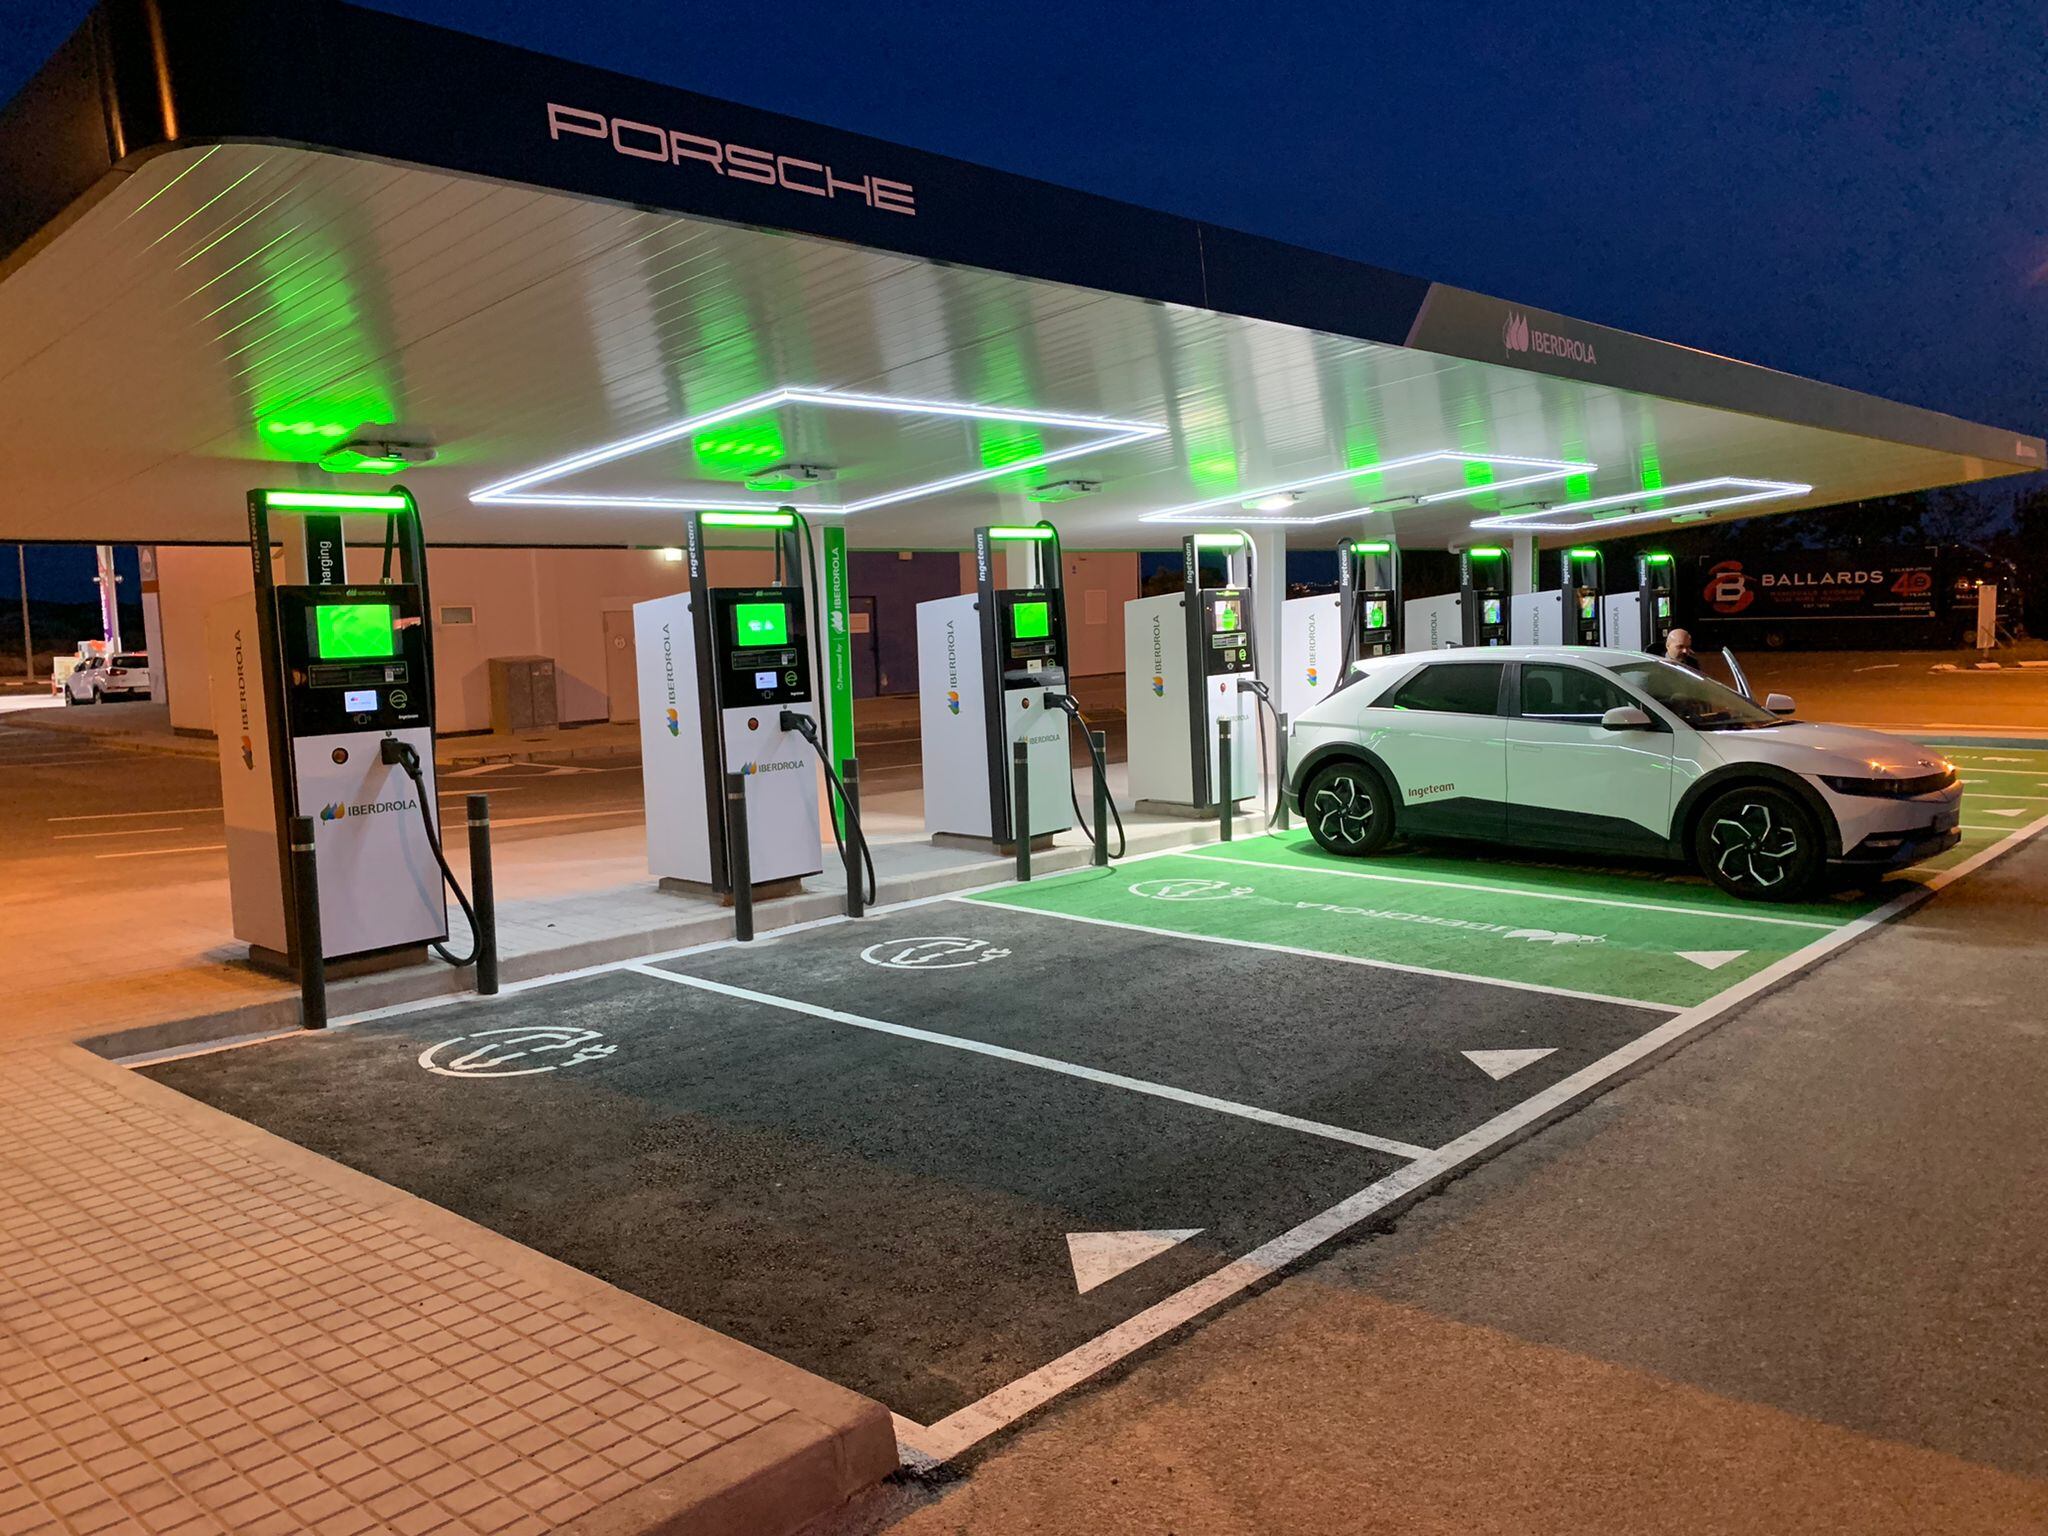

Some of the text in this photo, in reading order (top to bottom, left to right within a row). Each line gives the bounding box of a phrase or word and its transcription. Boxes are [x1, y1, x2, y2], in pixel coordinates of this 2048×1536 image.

[547, 102, 916, 216] PORSCHE
[1531, 330, 1597, 365] IBERDROLA
[318, 541, 333, 586] harging
[689, 521, 698, 578] Ingeteam
[978, 534, 986, 582] Ingeteam
[1187, 543, 1195, 584] Ingeteam
[833, 547, 842, 610] IBERDROLA
[1762, 570, 1884, 587] BALLARDS
[1151, 615, 1164, 674] IBERDROLA
[1308, 615, 1316, 666] IBERDROLA
[1430, 611, 1438, 650] ERDROLA
[661, 623, 677, 705] IBERDROLA
[944, 620, 958, 688] IBERDROLA
[234, 629, 250, 730] IBERDROLA
[1029, 733, 1061, 745] IBERDROLA
[758, 760, 805, 773] IBERDROLA
[347, 799, 418, 817] IBERDROLA
[1408, 783, 1455, 799] Ingeteam
